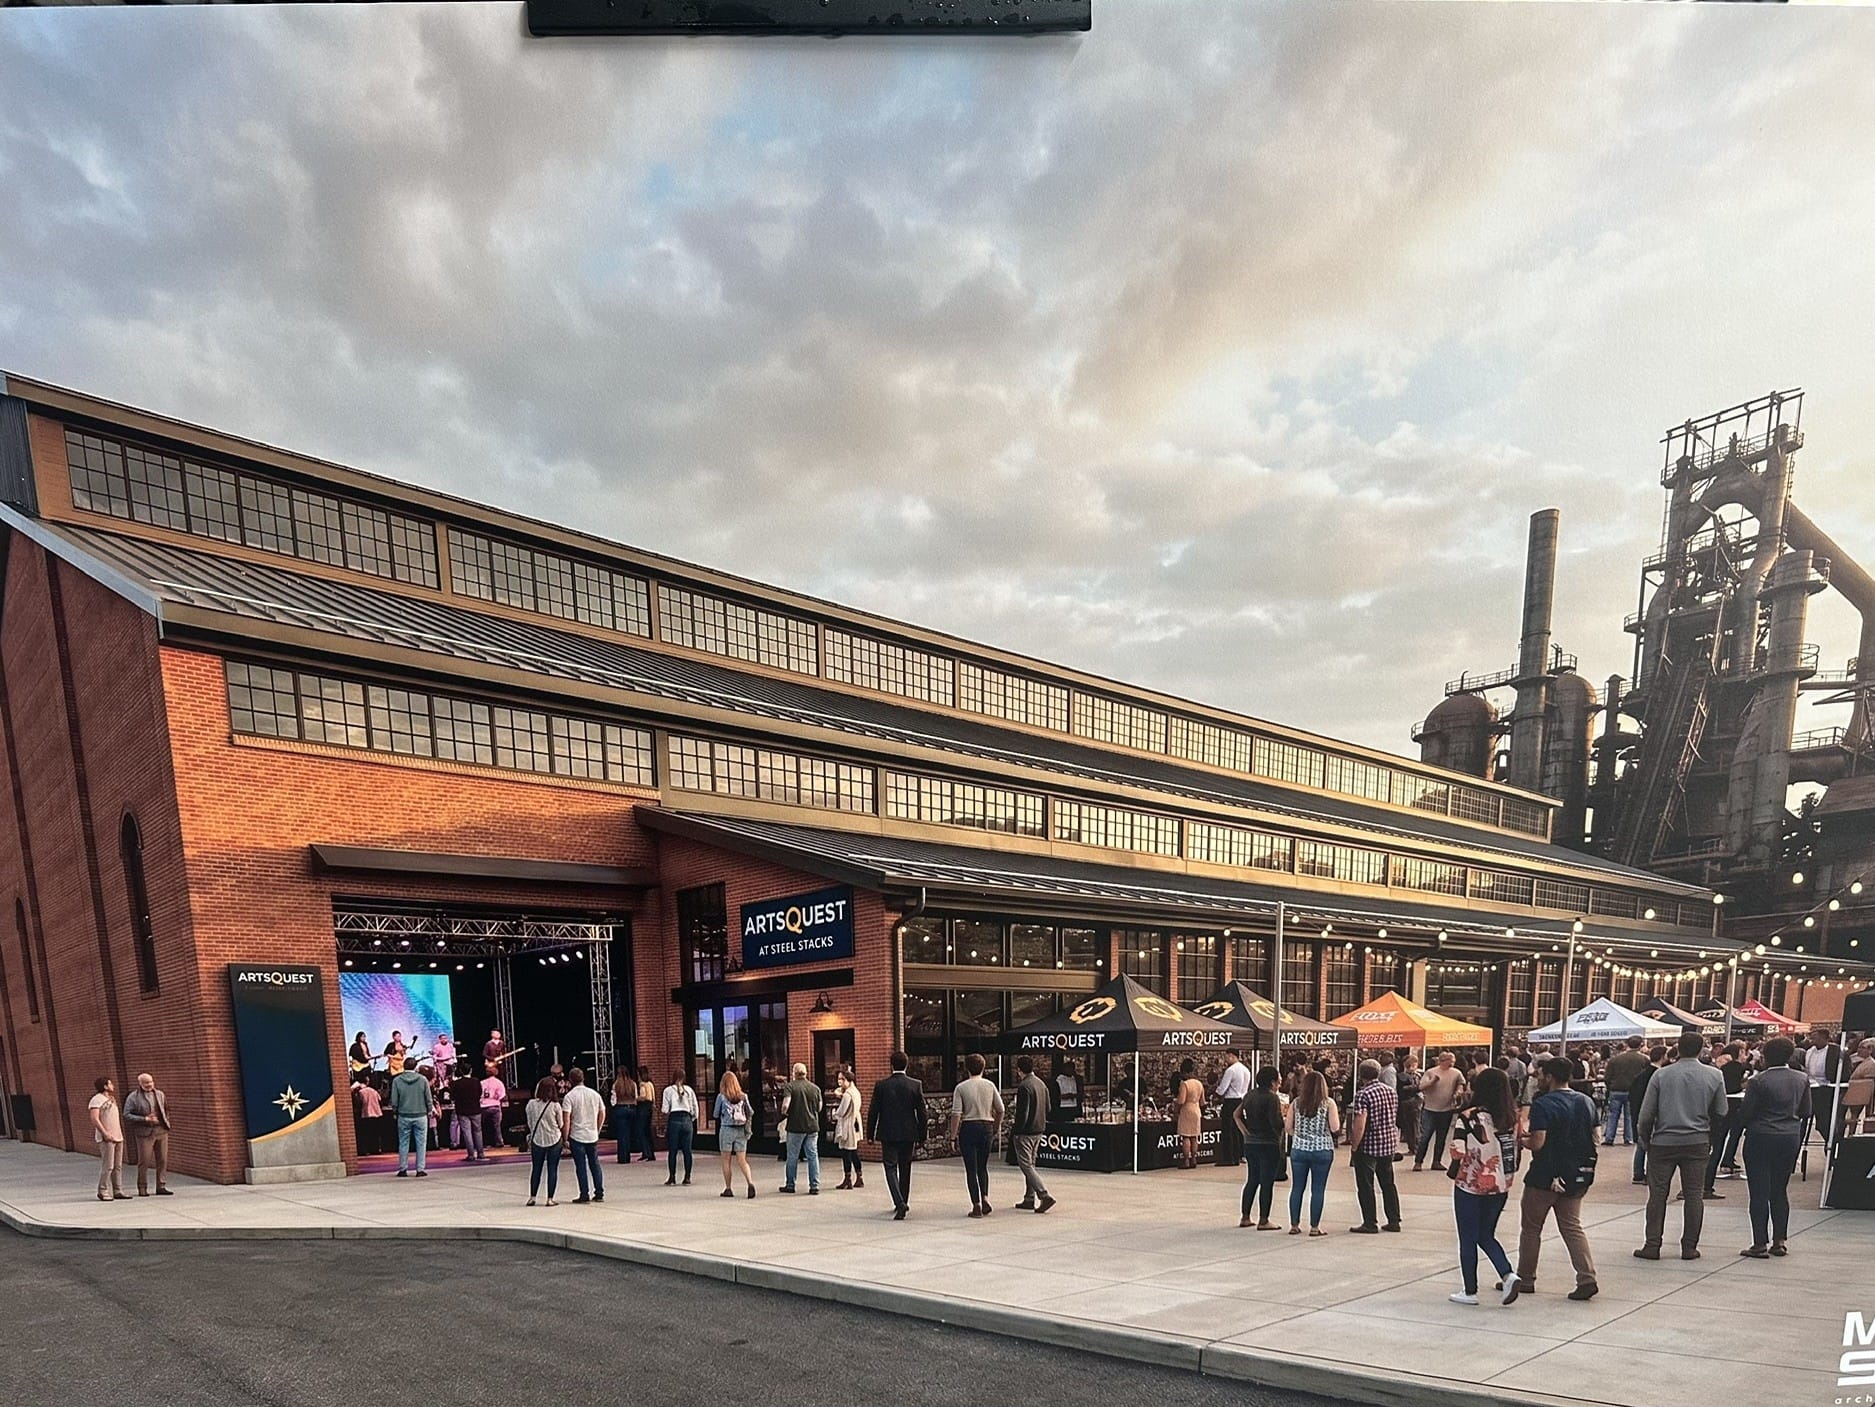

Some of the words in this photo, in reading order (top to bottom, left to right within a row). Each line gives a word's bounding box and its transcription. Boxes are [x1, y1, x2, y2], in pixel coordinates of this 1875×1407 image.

[744, 900, 847, 935] ARTSQUEST
[759, 945, 770, 957] AT
[770, 941, 796, 955] STEEL
[798, 935, 834, 951] STACKS
[238, 971, 314, 985] ARTSQUEST
[1022, 1033, 1105, 1049] ARTSQUEST
[1162, 1030, 1233, 1047] ARTSQUEST
[1280, 1031, 1339, 1046] ARTSQUEST
[1040, 1133, 1096, 1152] SQUEST
[1157, 1130, 1222, 1149] ARTUEST
